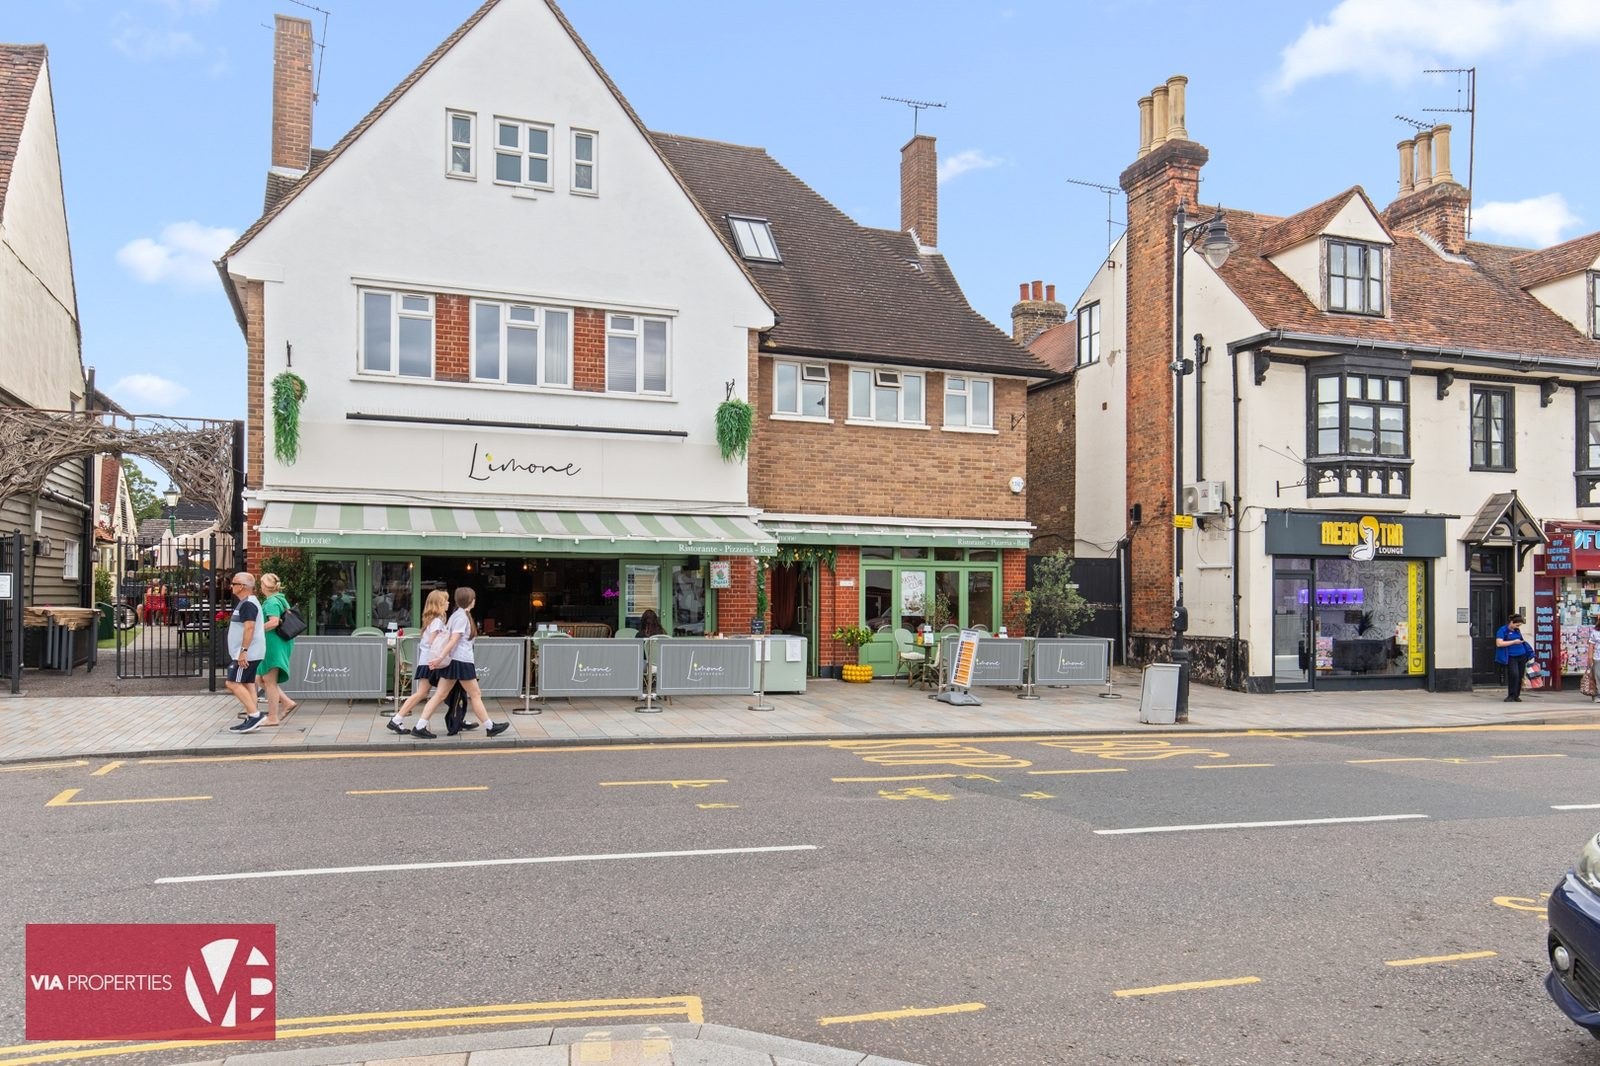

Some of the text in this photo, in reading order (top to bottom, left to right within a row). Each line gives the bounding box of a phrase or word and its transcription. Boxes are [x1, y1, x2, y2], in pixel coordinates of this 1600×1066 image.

[469, 442, 582, 481] Limone
[678, 543, 718, 553] Ristorante
[724, 544, 754, 553] Pizzeria
[760, 545, 774, 554] Bar
[1321, 521, 1404, 547] MEGA TAN
[1378, 547, 1404, 555] LOUNGE
[304, 649, 351, 684] Limone
[571, 649, 612, 683] Limone
[687, 650, 725, 682] Limone
[1036, 740, 1231, 760] BUS
